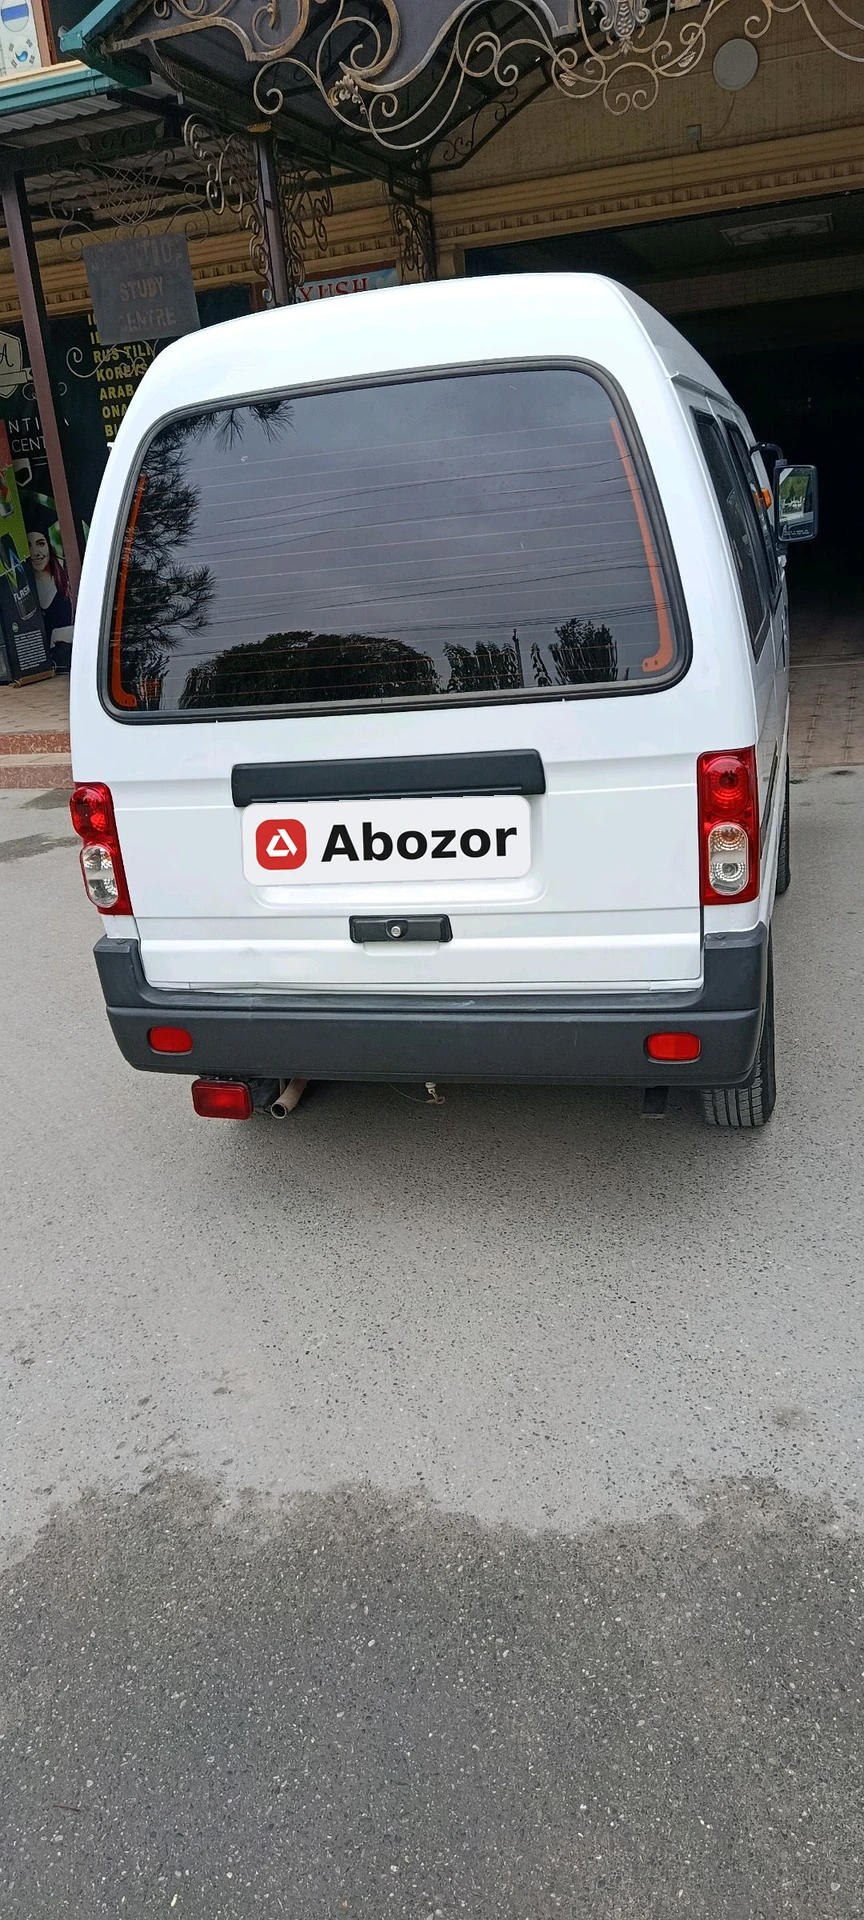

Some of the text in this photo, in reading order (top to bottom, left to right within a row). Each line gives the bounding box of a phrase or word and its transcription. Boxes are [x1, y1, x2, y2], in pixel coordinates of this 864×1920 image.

[119, 276, 164, 301] STUDY
[93, 349, 120, 363] RUS
[100, 384, 135, 401] ARAB
[102, 404, 128, 419] ONA
